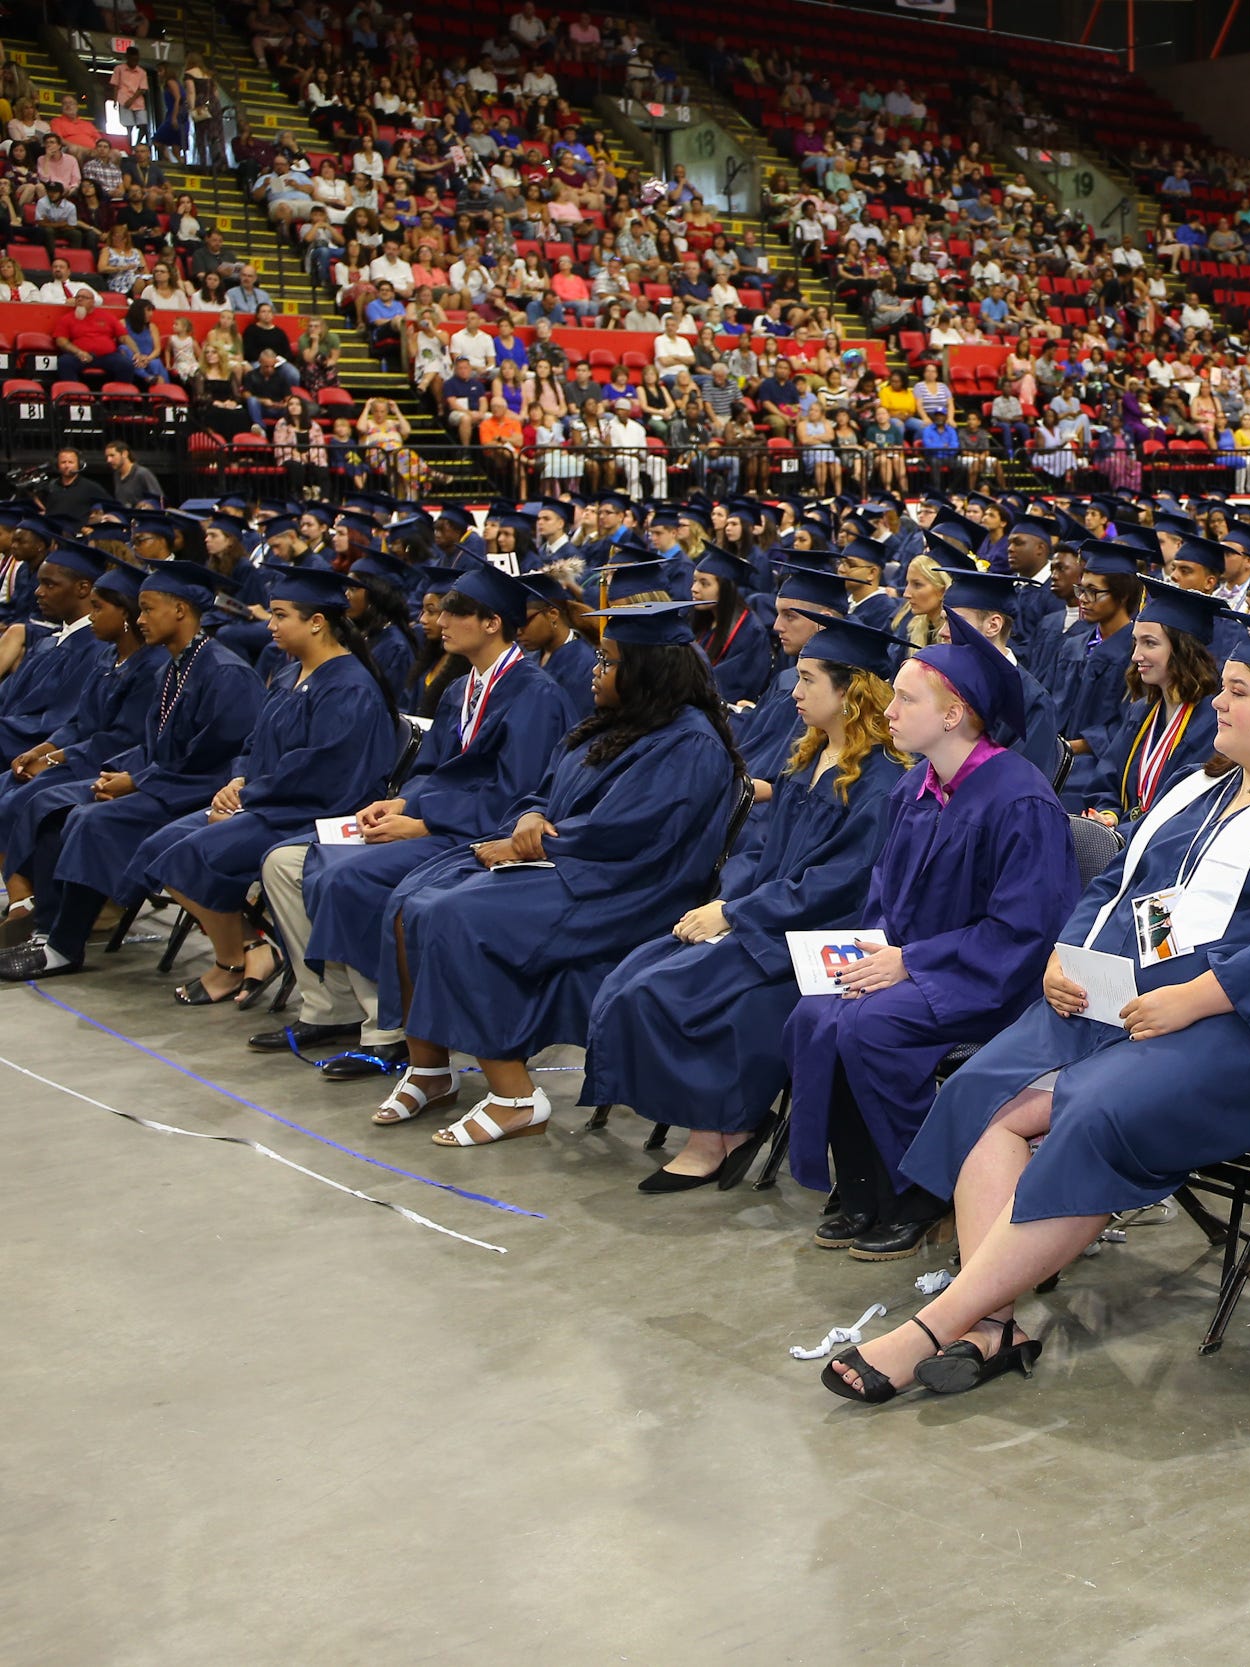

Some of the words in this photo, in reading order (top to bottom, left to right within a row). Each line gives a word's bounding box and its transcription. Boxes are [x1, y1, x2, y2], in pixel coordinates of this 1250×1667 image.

[152, 41, 170, 60] 17
[1073, 171, 1094, 198] 19
[42, 356, 50, 369] 9
